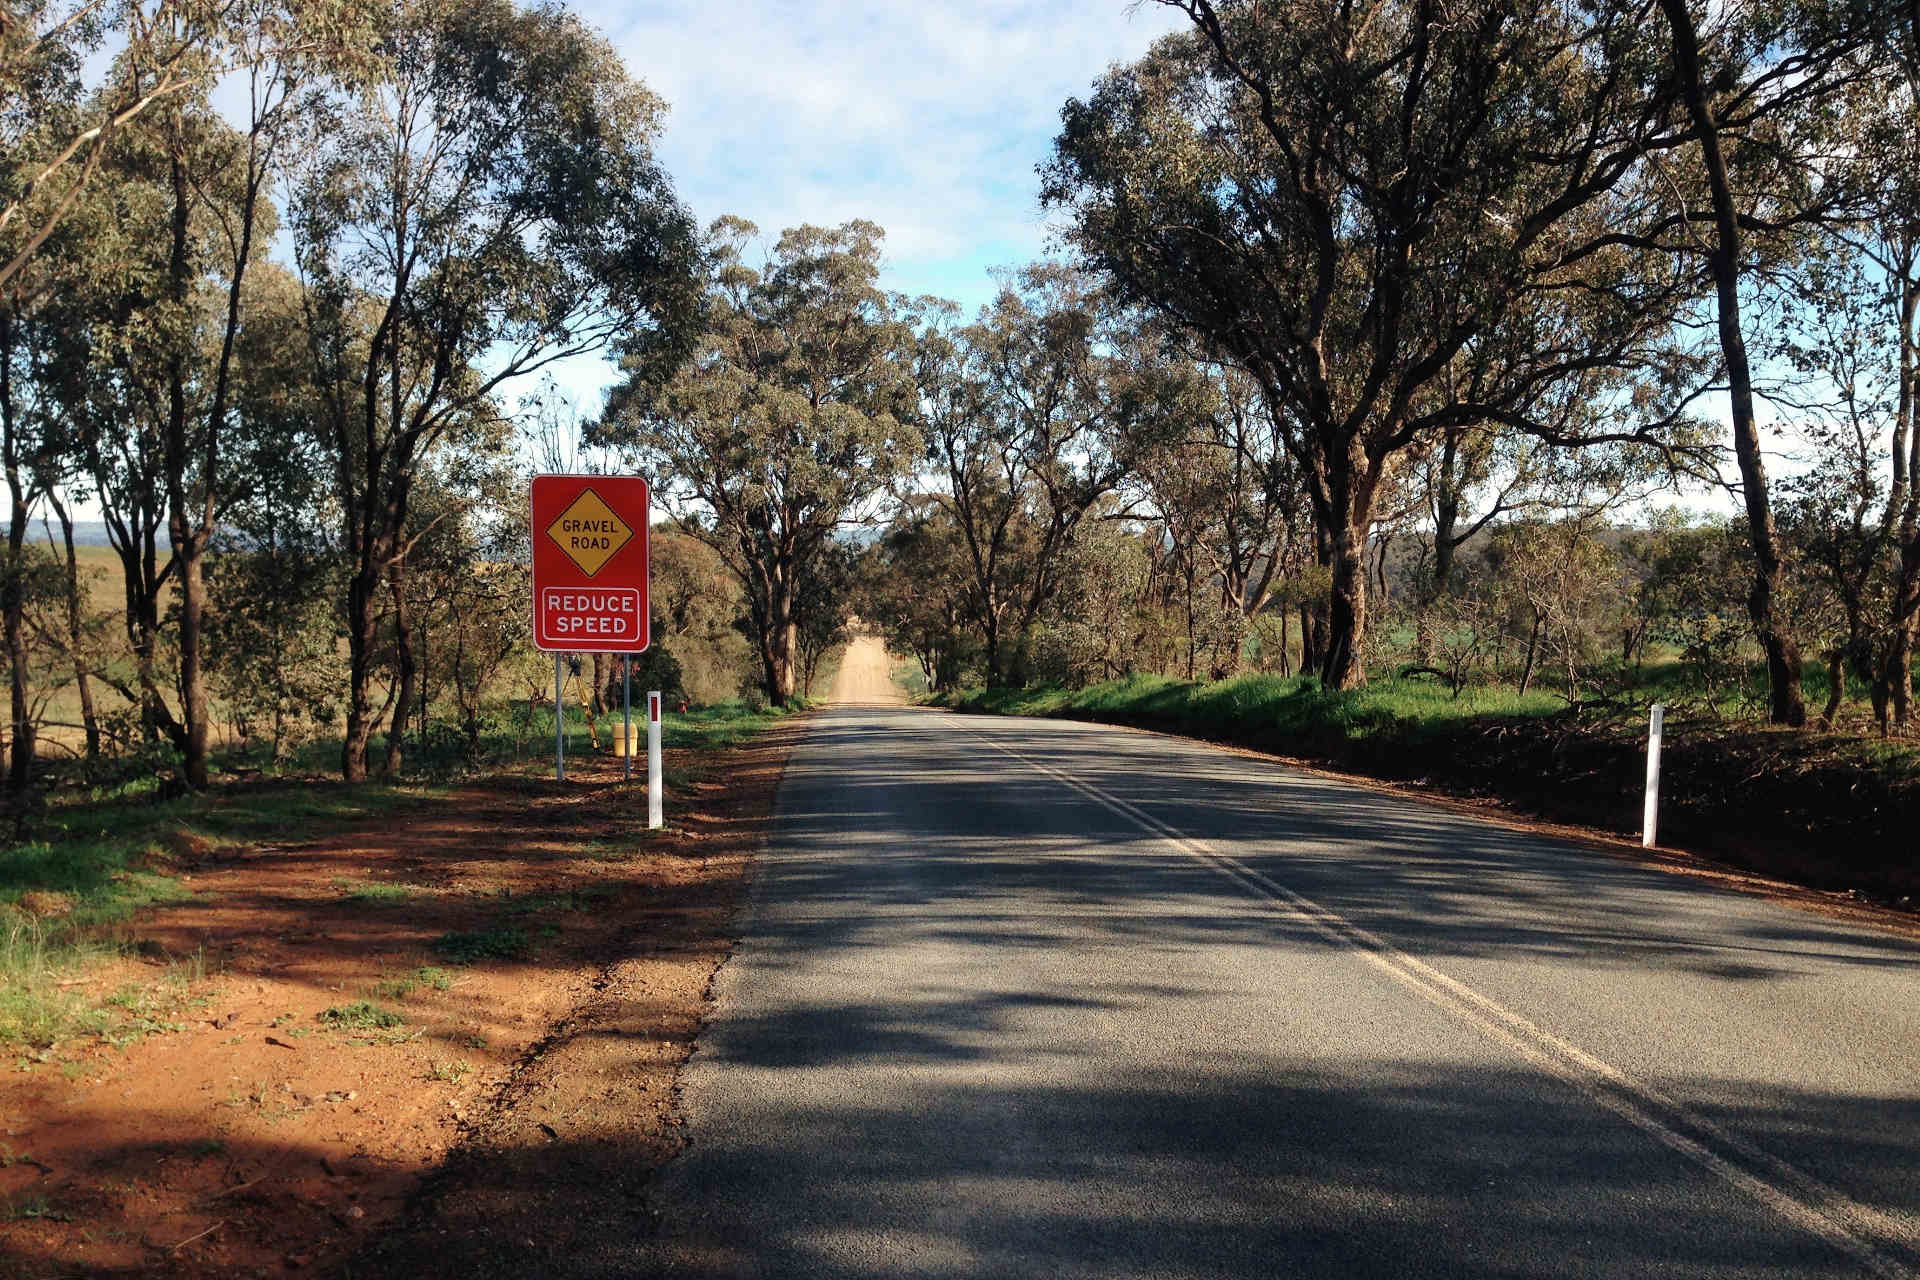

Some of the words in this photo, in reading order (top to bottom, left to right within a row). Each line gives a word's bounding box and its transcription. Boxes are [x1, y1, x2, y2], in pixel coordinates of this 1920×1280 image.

[562, 519, 618, 533] GRAVEL
[571, 536, 610, 550] ROAD
[548, 595, 634, 612] REDUCE
[556, 616, 627, 633] SPEED
